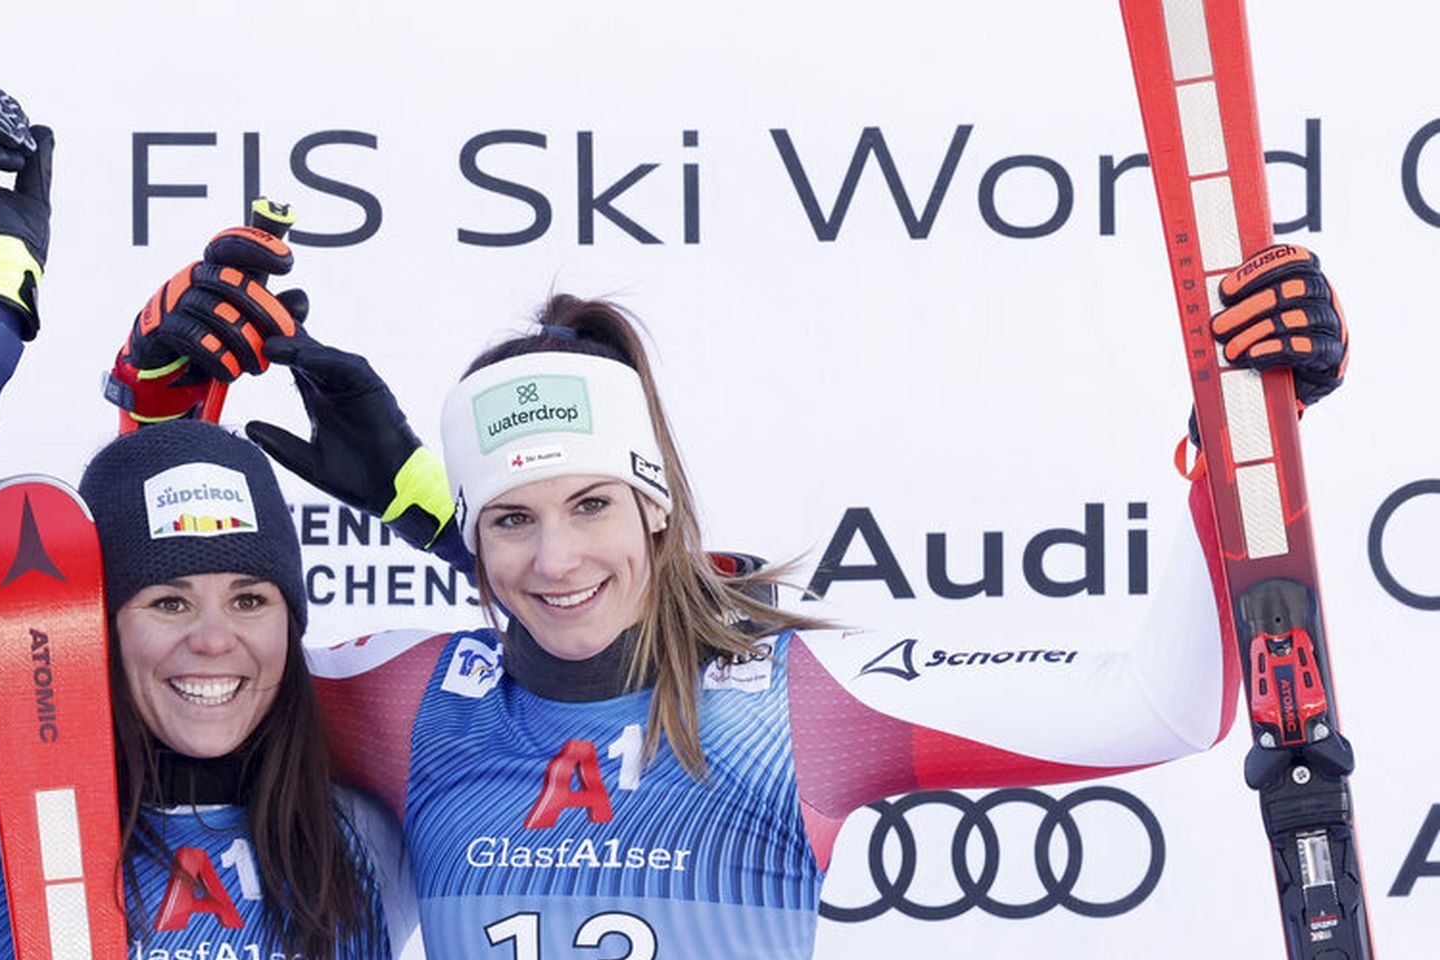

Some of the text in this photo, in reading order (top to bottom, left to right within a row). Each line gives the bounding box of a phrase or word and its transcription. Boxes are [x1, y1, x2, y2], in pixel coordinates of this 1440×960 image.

[132, 130, 383, 248] FIS
[457, 128, 700, 247] Ski
[768, 117, 1321, 242] Word
[1235, 245, 1297, 281] reusch
[488, 404, 579, 437] waterdrop
[801, 502, 1149, 601] Audi
[28, 627, 59, 745] ATOMIC
[523, 723, 644, 829] A1
[153, 838, 263, 932] A1
[466, 837, 692, 872] GlasfA1ser
